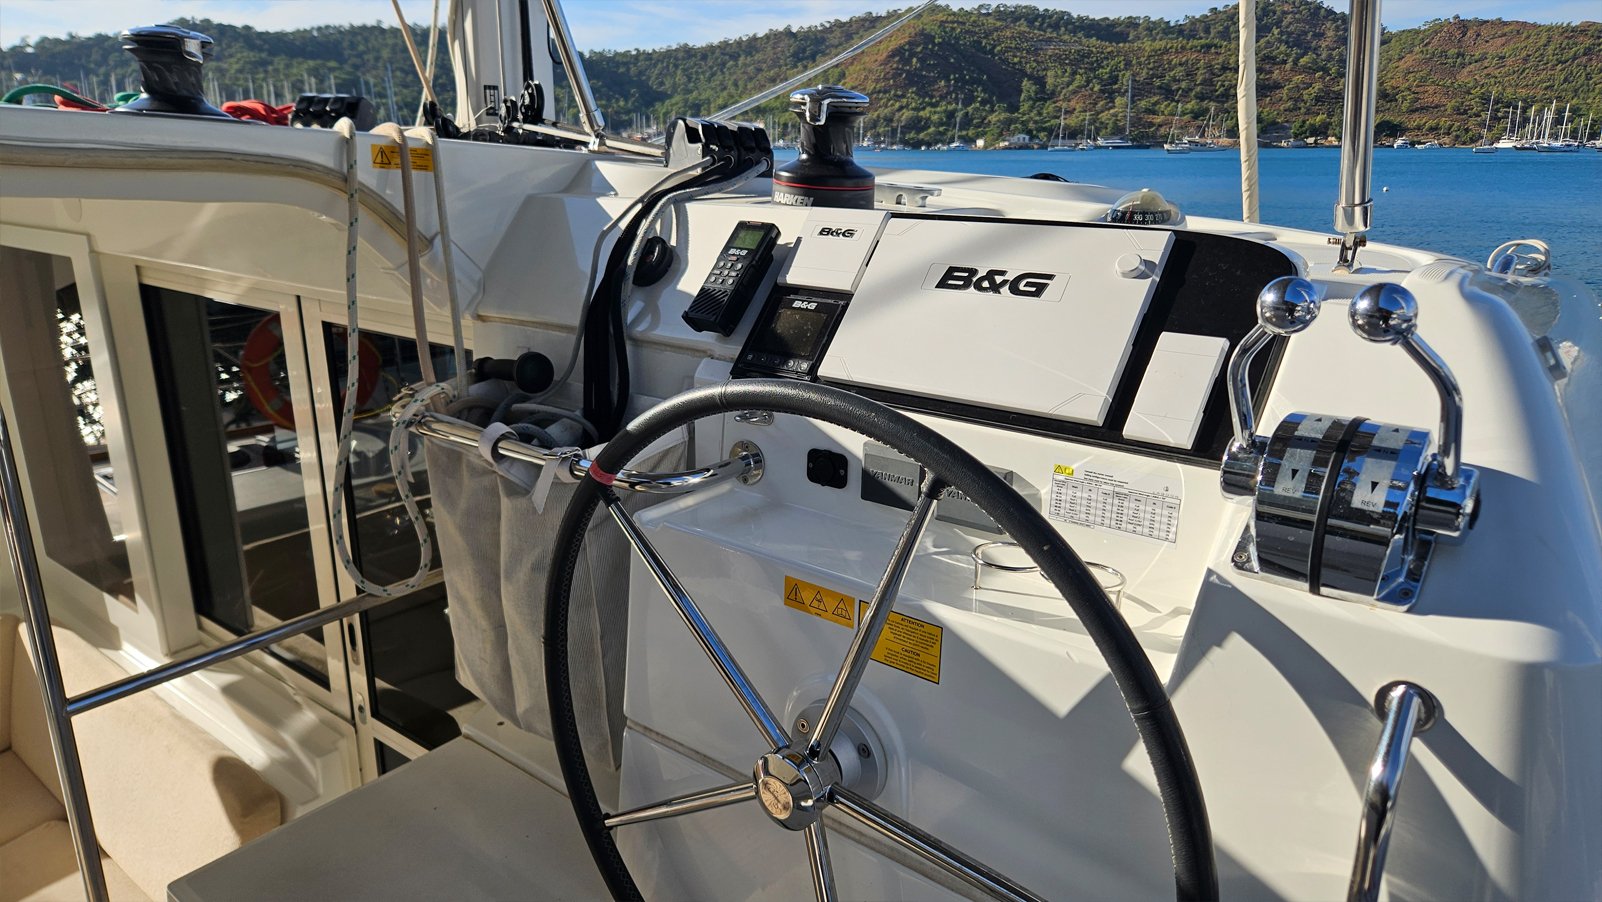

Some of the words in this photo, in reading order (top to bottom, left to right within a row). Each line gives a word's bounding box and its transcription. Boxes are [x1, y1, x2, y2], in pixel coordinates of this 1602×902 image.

[774, 191, 813, 206] HARKEN
[1144, 213, 1154, 221] 300
[817, 227, 858, 238] B&G
[935, 265, 1056, 299] B&G
[792, 301, 818, 309] B&G
[870, 469, 915, 487] YANMAR
[901, 617, 925, 629] ATTENTION
[901, 647, 921, 658] CAUTION
